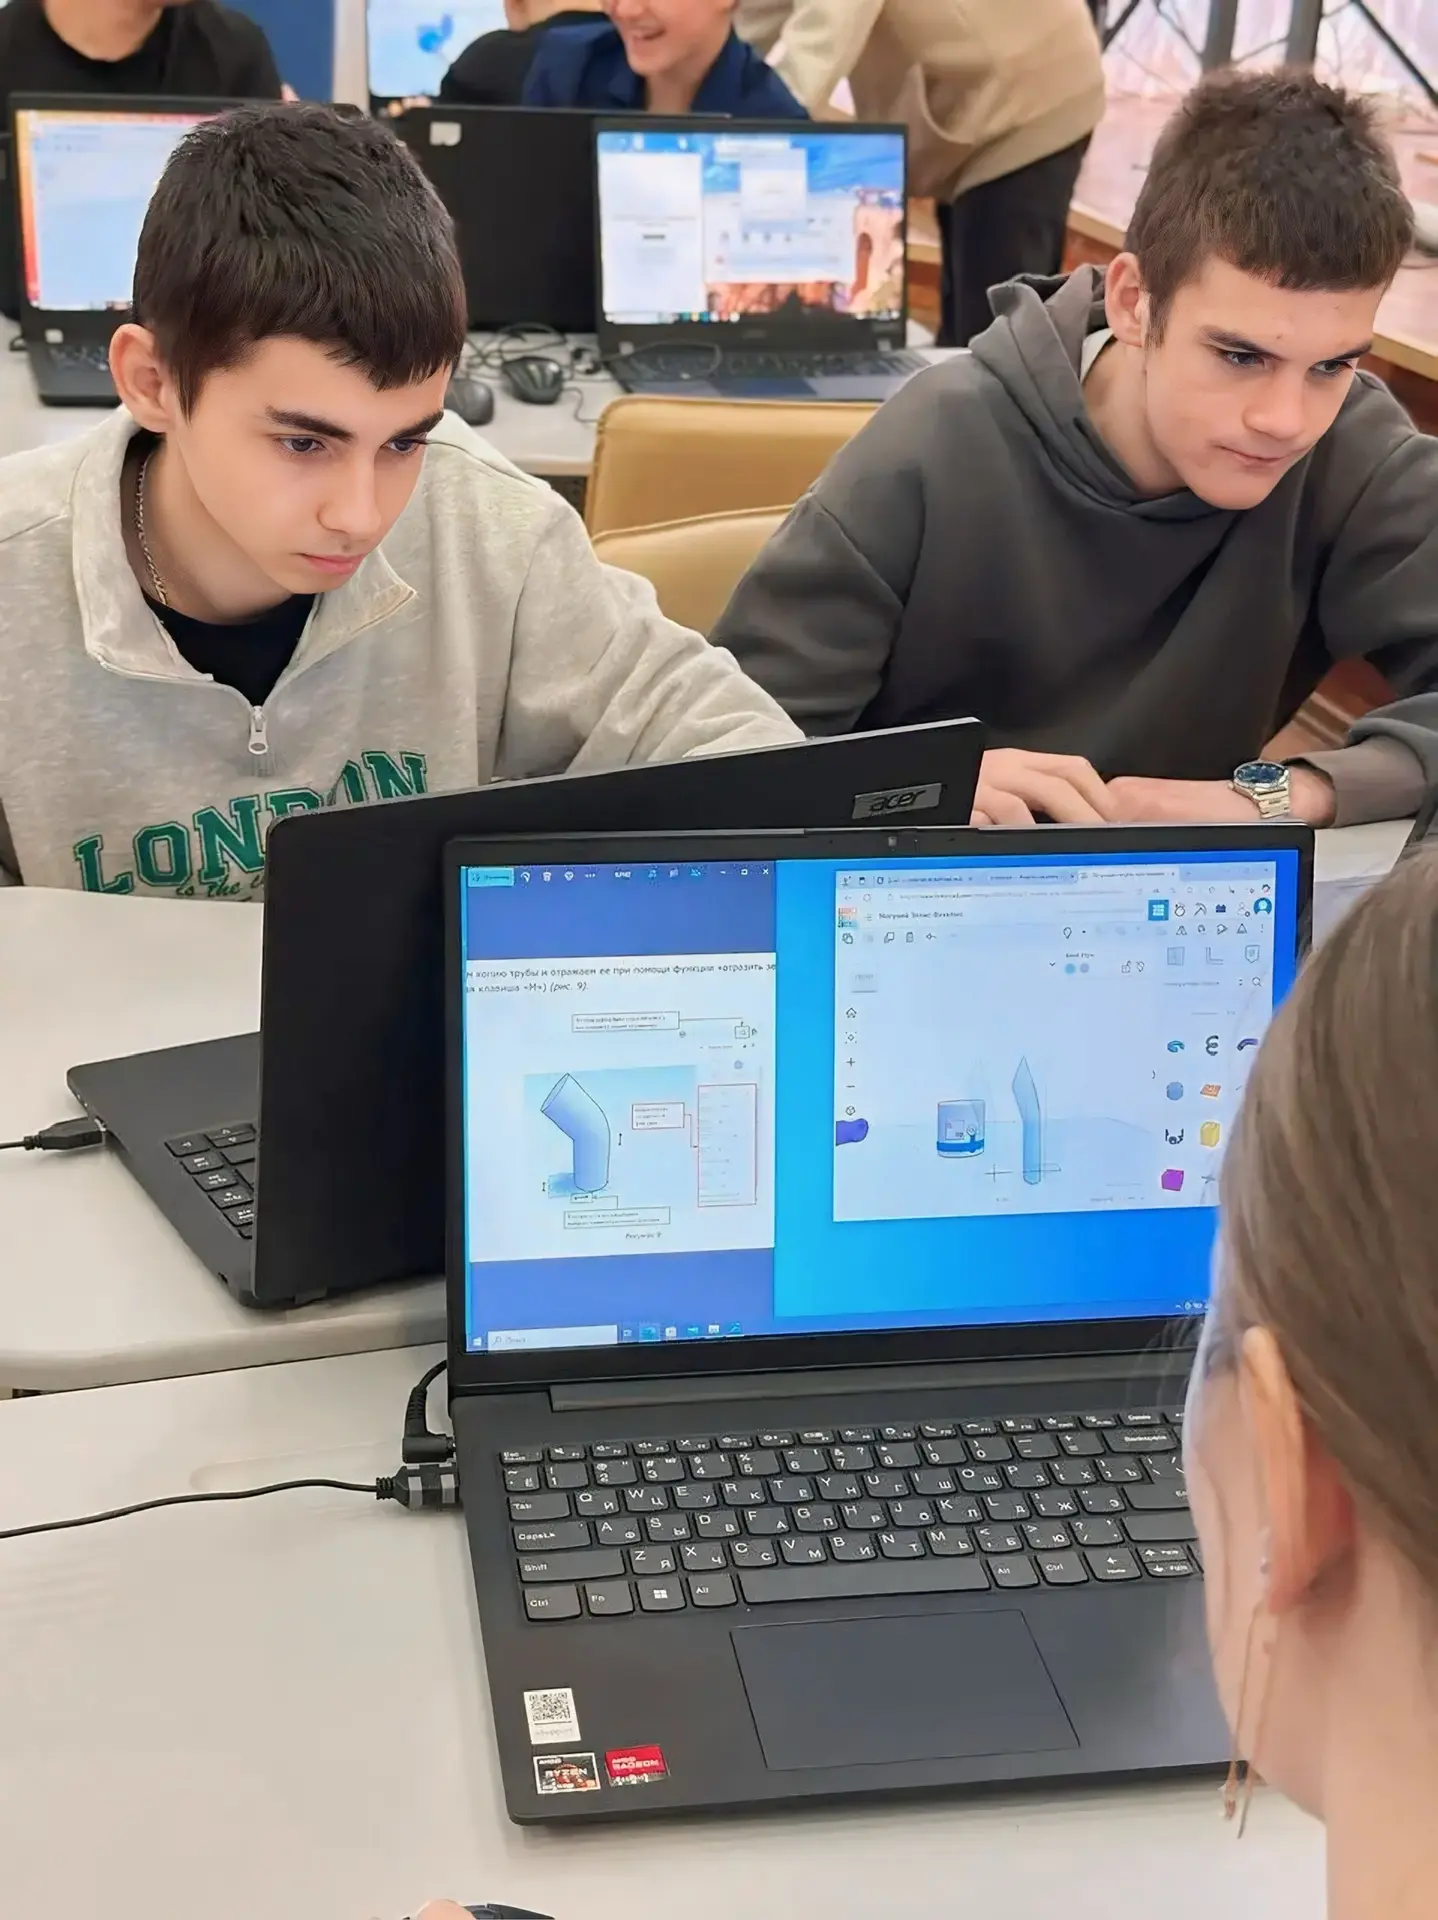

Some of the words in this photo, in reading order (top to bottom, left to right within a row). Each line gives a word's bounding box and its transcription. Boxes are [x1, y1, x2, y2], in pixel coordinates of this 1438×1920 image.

[868, 790, 927, 812] acer
[510, 968, 539, 980] трубы
[836, 1457, 846, 1468] 7
[647, 1469, 659, 1480] 3
[696, 1466, 706, 1475] 4
[961, 1468, 975, 1479] O
[1007, 1465, 1019, 1475] P
[772, 1479, 784, 1489] T
[820, 1476, 831, 1487] Y
[866, 1474, 880, 1485] U
[938, 1480, 952, 1489] Ш
[983, 1475, 999, 1486] Щ
[676, 1485, 690, 1497] E
[724, 1482, 738, 1493] R
[845, 1486, 858, 1496] Н
[627, 1488, 644, 1499] W
[749, 1491, 761, 1500] К
[650, 1497, 665, 1507] Ц
[940, 1499, 954, 1510] K
[987, 1496, 1000, 1507] L
[1057, 1501, 1073, 1511] Ж
[797, 1507, 811, 1519] G
[844, 1504, 858, 1516] H
[894, 1502, 903, 1513] J
[699, 1514, 712, 1525] D
[747, 1510, 757, 1521] F
[919, 1511, 930, 1521] О
[600, 1521, 613, 1533] A
[650, 1516, 662, 1528] S
[776, 1520, 789, 1530] А
[823, 1517, 834, 1527] П
[673, 1527, 686, 1537] Ы
[929, 1530, 947, 1541] M
[832, 1536, 846, 1547] B
[881, 1533, 896, 1544] N
[1051, 1533, 1066, 1543] Ю
[734, 1542, 748, 1554] C
[784, 1539, 796, 1550] V
[908, 1543, 919, 1553] Т
[634, 1550, 647, 1561] Z
[684, 1545, 698, 1557] X
[760, 1552, 772, 1561] С
[808, 1548, 822, 1559] М
[859, 1546, 871, 1556] И
[660, 1559, 672, 1569] Я
[711, 1555, 723, 1565] Ч
[524, 1562, 548, 1572] Shift
[544, 1766, 589, 1779] RYZEN
